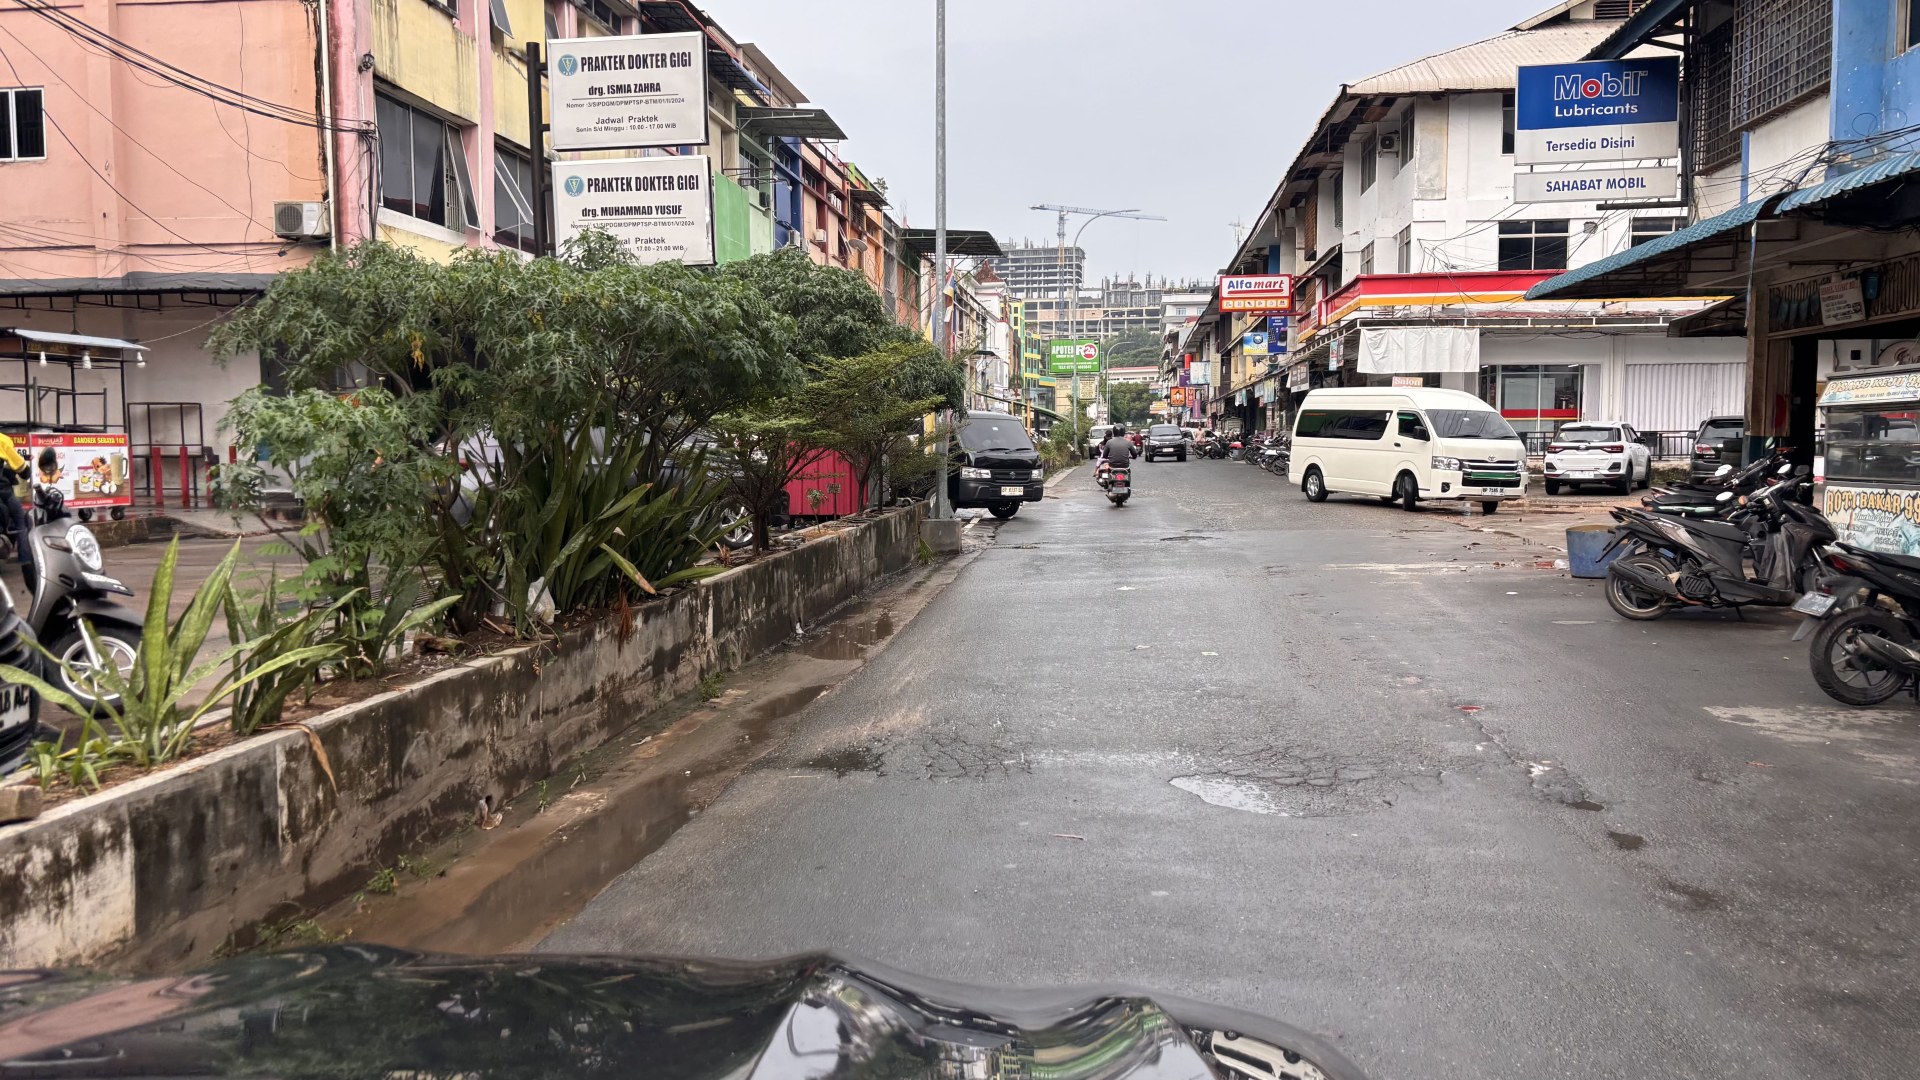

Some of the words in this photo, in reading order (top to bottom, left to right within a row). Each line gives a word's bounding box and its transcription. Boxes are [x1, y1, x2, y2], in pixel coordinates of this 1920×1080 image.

[580, 54, 626, 73] PRAKTEK
[627, 52, 668, 70] DOKTER
[669, 51, 692, 68] GIGI
[588, 85, 606, 98] drg.
[607, 84, 632, 95] ISMIA
[633, 82, 661, 94] ZAHRA
[1554, 71, 1641, 101] Mobil
[1555, 103, 1638, 117] Lubricants
[595, 116, 624, 125] Jadwal
[628, 115, 659, 123] Praktek
[604, 125, 625, 133] Minggu
[1546, 138, 1597, 152] Tersedia
[1600, 136, 1635, 149] Disini
[587, 176, 633, 193] PRAKTEK
[635, 175, 675, 192] DOKTER
[677, 174, 699, 190] GIGI
[1546, 178, 1603, 193] SAHABAT
[1606, 177, 1646, 190] MOBIL
[581, 207, 599, 218] drg.
[600, 205, 653, 217] MUHAMMAD
[655, 205, 683, 215] YUSUF
[635, 237, 666, 245] Praktek
[1827, 489, 1858, 517] ROTI
[1858, 489, 1902, 517] BAKAR
